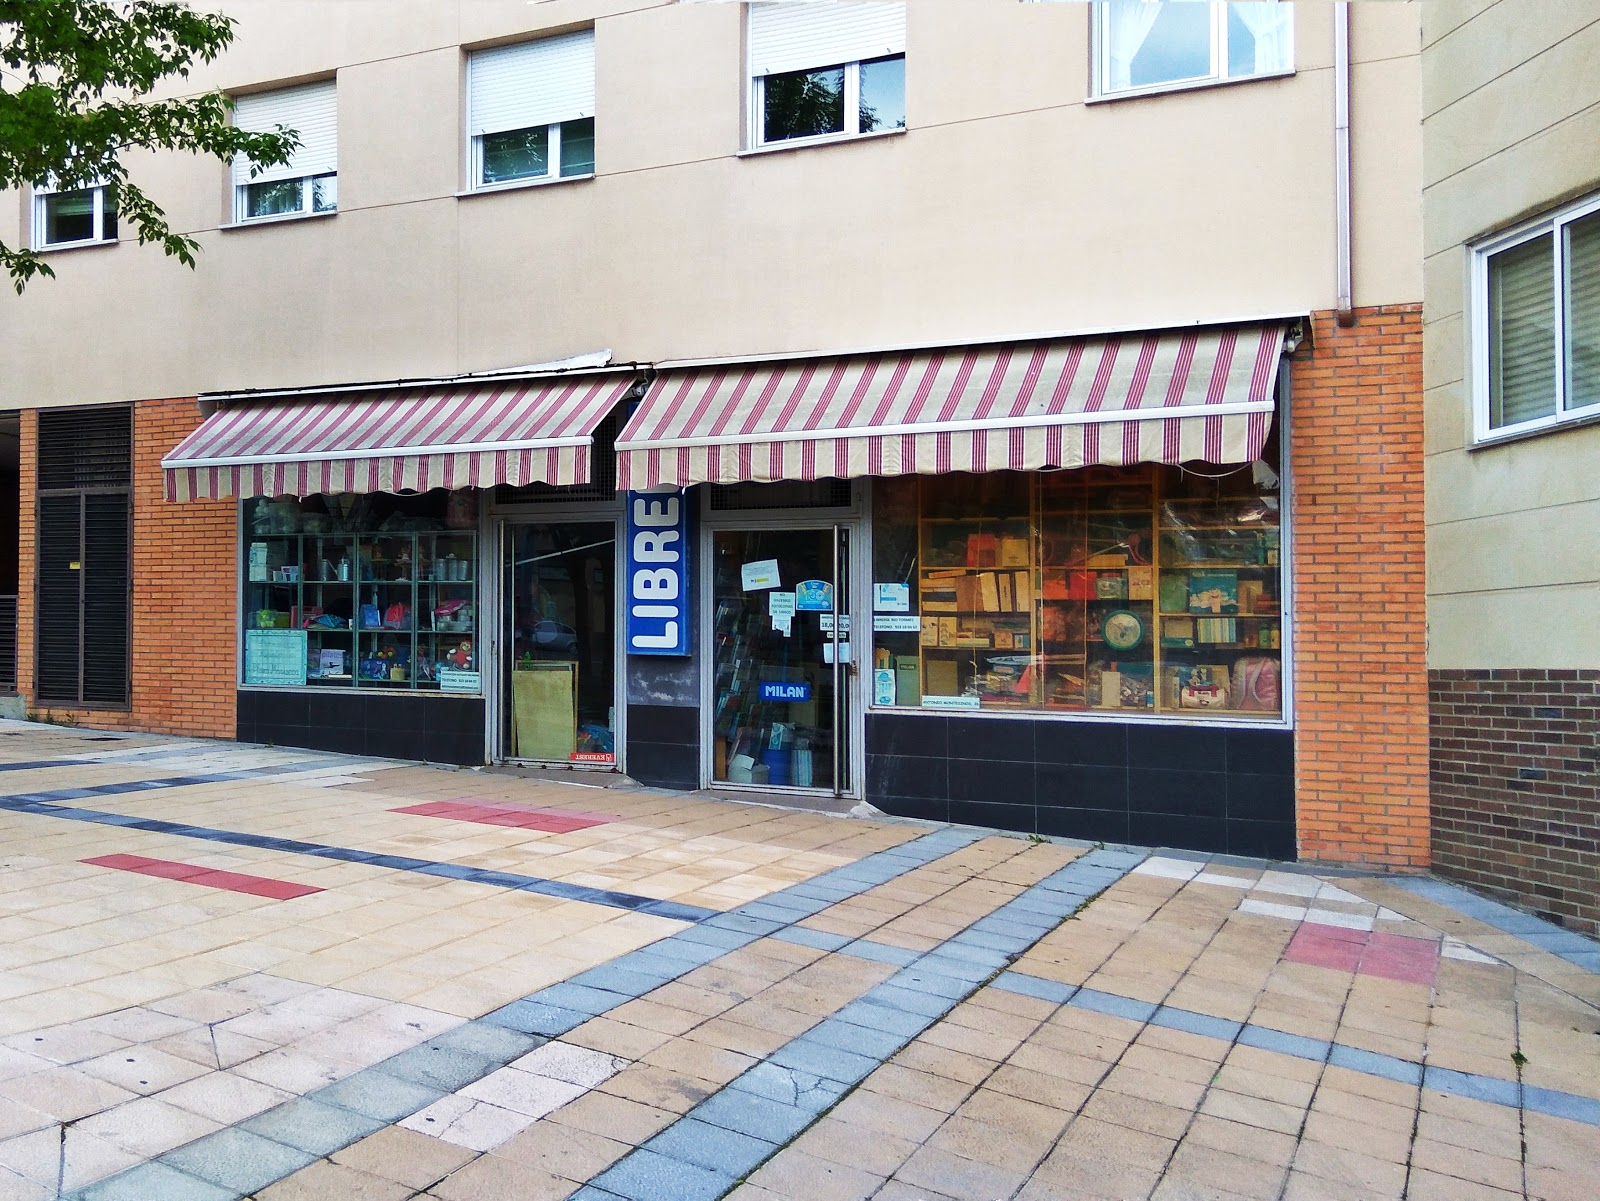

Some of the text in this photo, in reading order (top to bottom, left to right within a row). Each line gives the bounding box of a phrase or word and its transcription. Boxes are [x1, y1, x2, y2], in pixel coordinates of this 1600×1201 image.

[632, 483, 680, 649] LIBRE
[321, 651, 343, 659] pilates
[765, 685, 804, 698] MILAN
